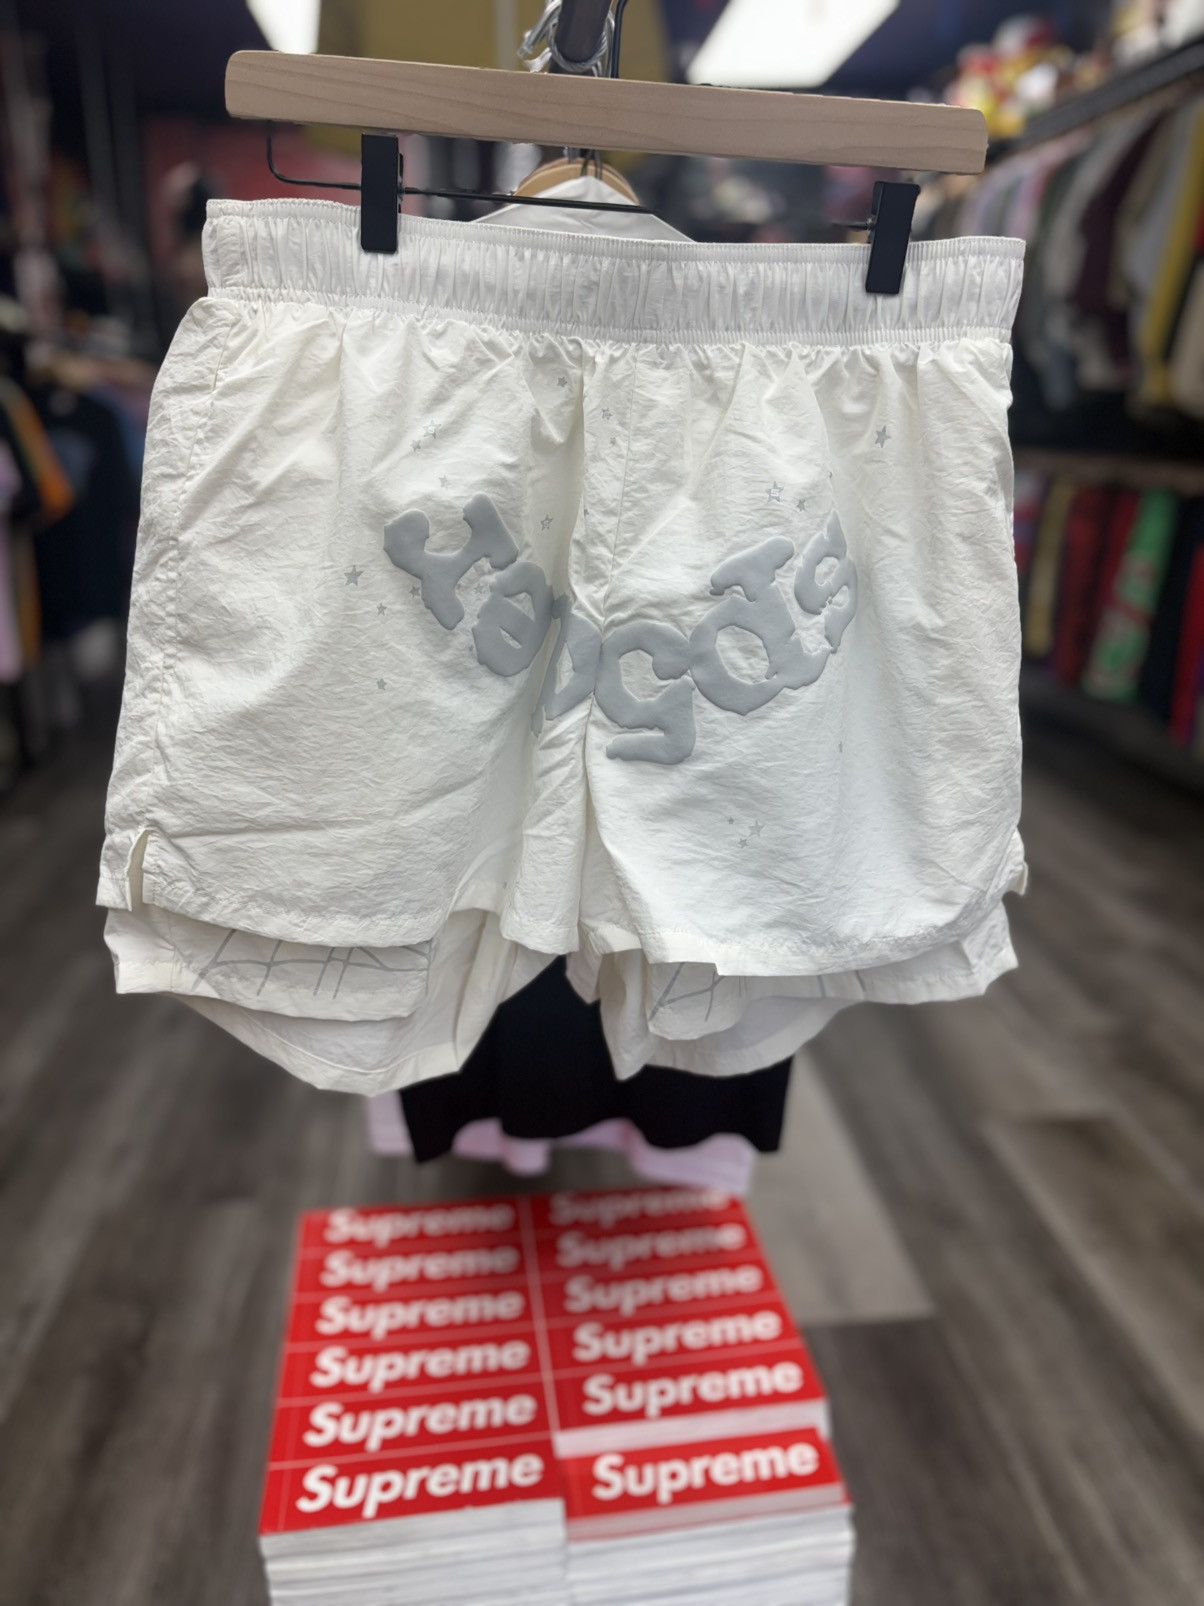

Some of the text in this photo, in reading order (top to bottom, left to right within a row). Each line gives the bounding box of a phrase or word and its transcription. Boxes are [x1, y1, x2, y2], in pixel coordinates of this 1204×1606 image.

[315, 1291, 525, 1338] Supreme
[564, 1264, 763, 1315] Supreme
[573, 1310, 782, 1364] Supreme
[310, 1338, 531, 1392] Supreme
[583, 1361, 804, 1418] Supreme
[304, 1394, 537, 1450] Supreme
[296, 1453, 544, 1518] Supreme
[591, 1442, 820, 1503] Supreme
